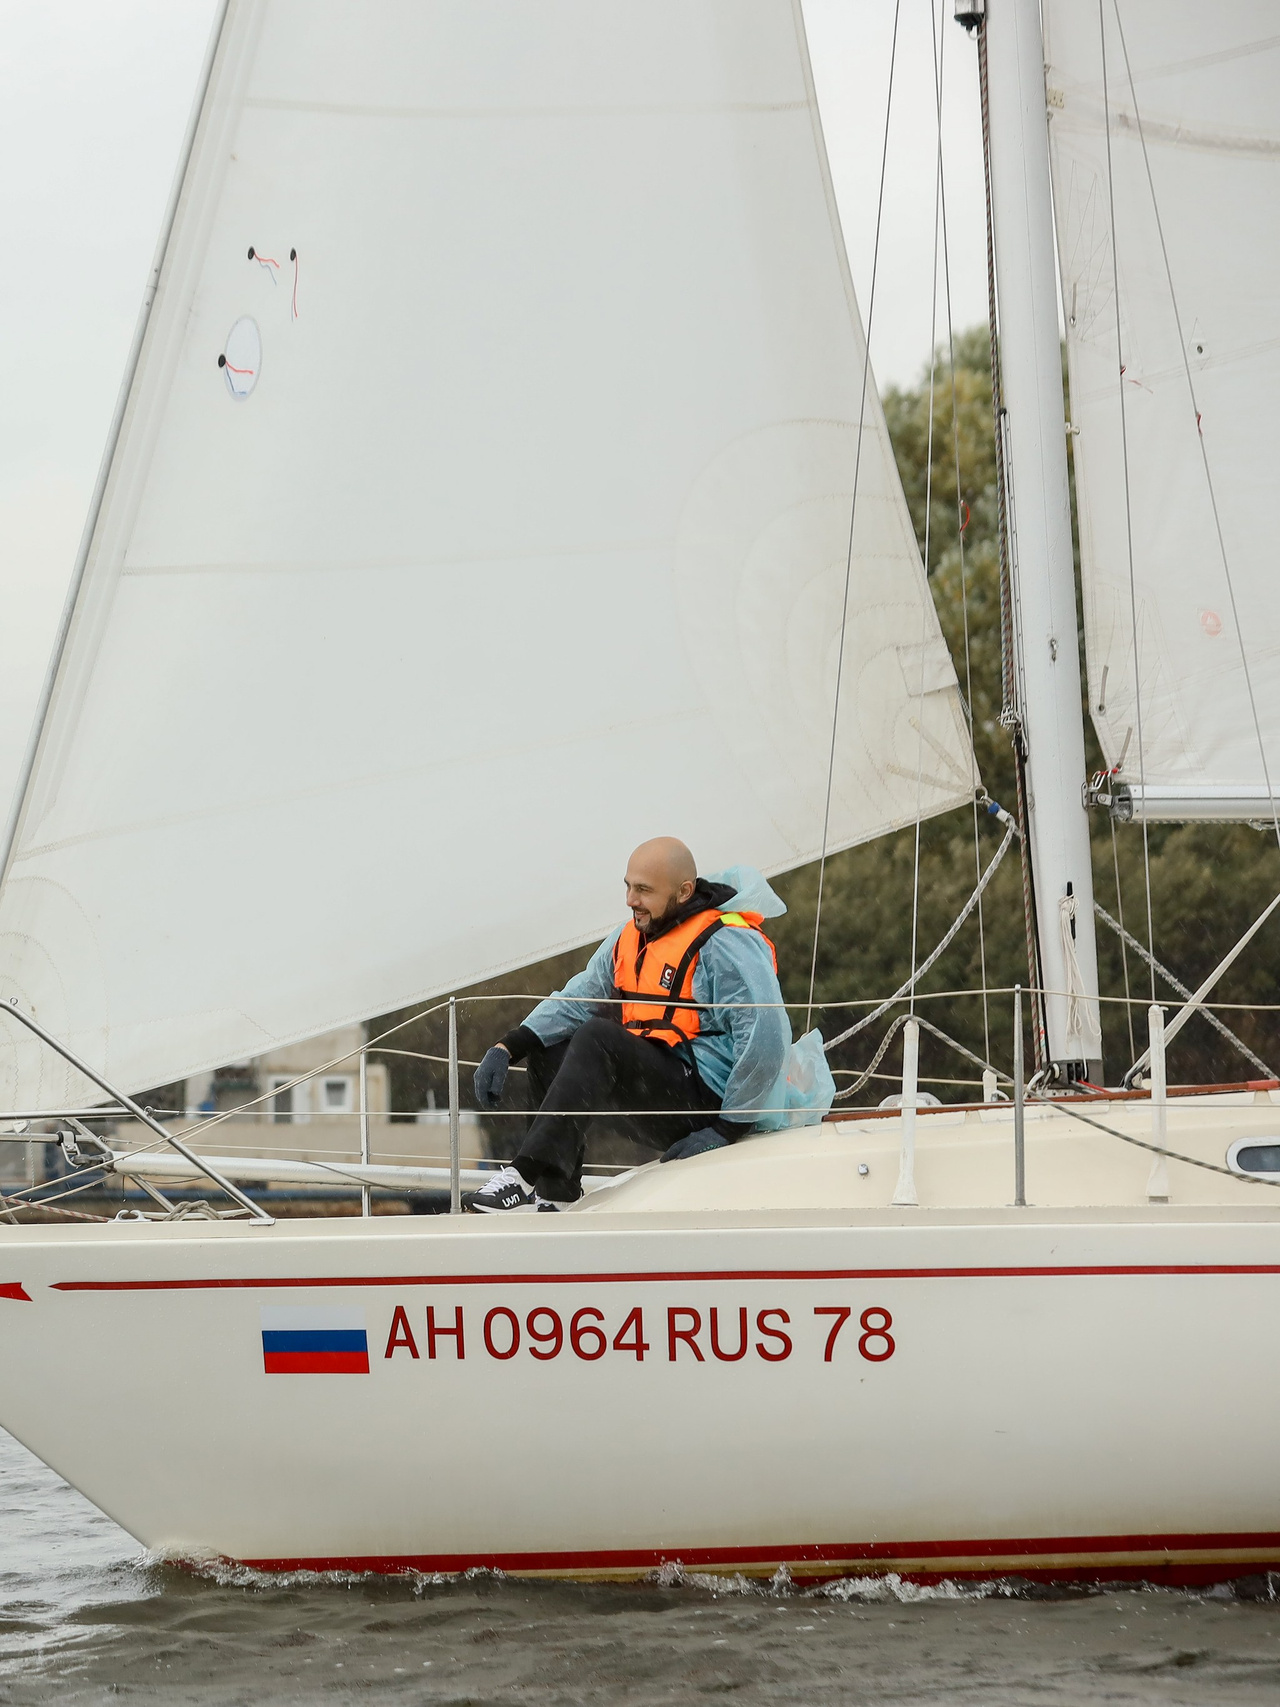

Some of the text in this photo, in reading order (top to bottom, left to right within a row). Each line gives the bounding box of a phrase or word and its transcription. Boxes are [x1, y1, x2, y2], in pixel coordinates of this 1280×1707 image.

[385, 1305, 896, 1363] AH 0964 RUS 78
